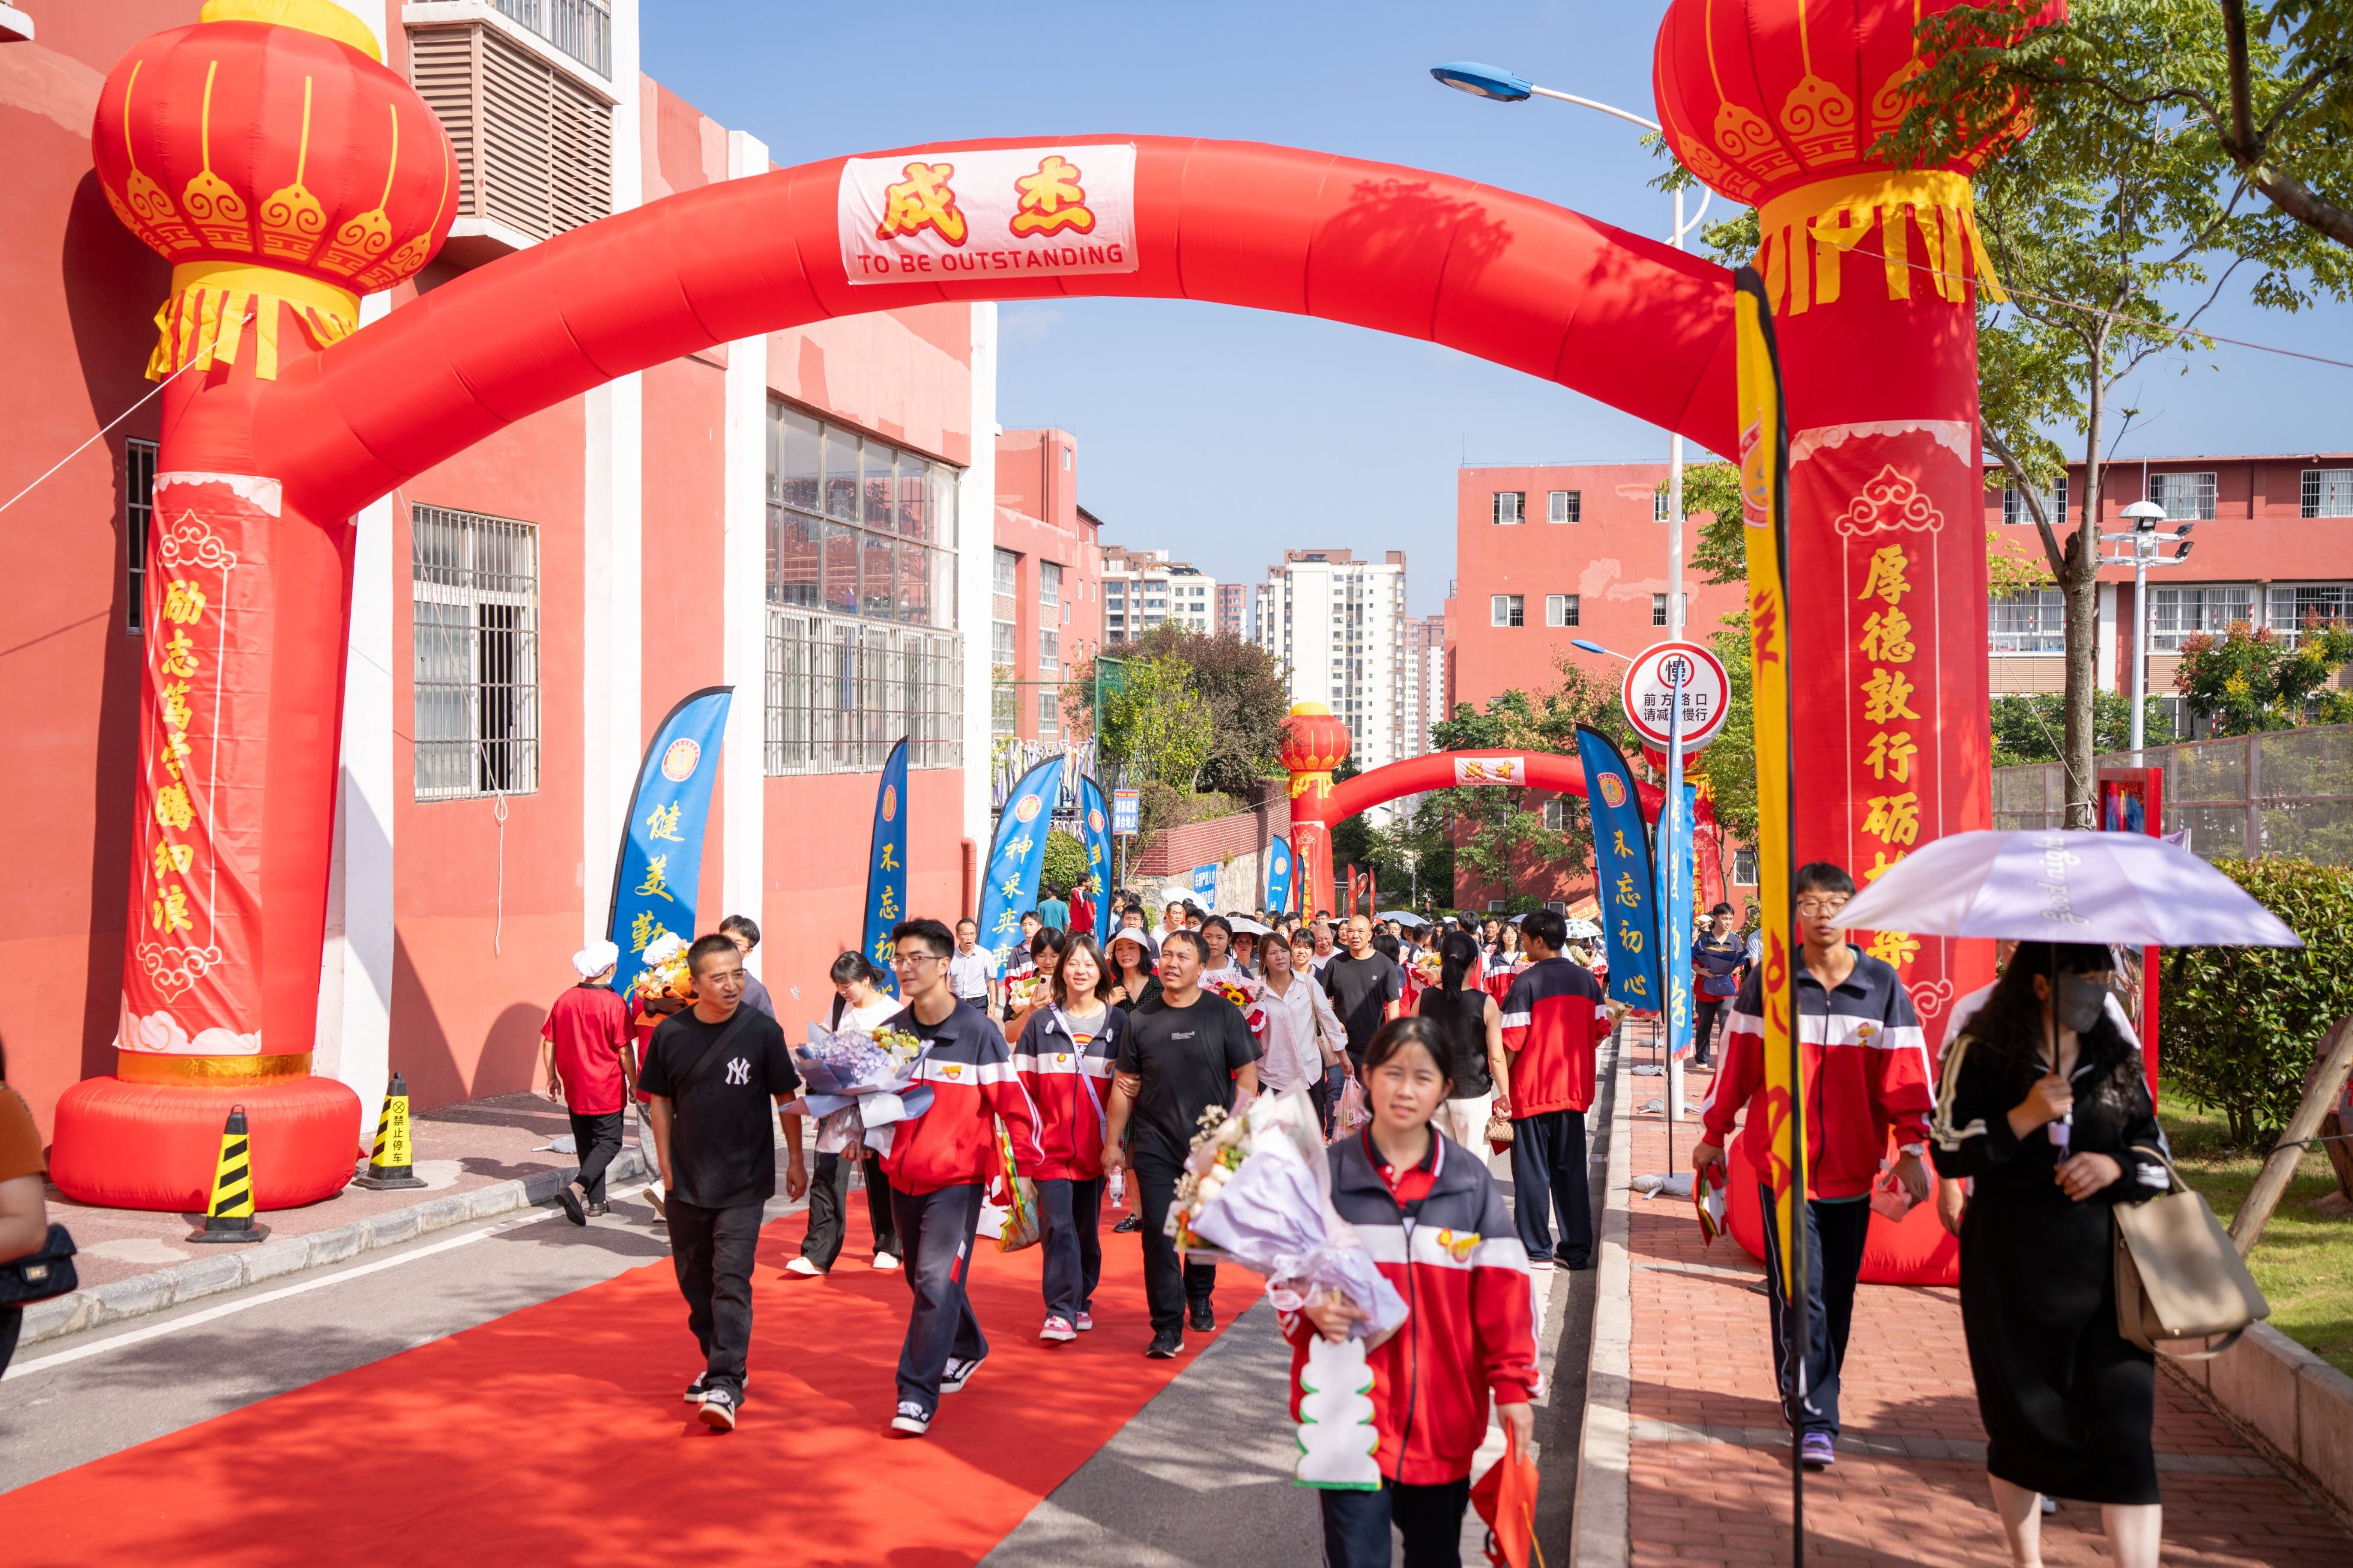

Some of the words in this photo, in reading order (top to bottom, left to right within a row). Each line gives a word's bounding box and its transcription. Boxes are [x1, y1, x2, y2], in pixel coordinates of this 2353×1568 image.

[875, 155, 1096, 247] 成杰
[858, 255, 890, 273] TO
[900, 253, 932, 272] BE
[941, 244, 1123, 271] OUTSTANDING
[1665, 660, 1686, 682] 慢
[1644, 693, 1707, 706] 前方路口
[1643, 708, 1708, 721] 请减慢行
[152, 579, 207, 934] 励志笃学腾细浪
[1114, 815, 1136, 828] 集合地点
[1614, 829, 1646, 995] 不忘初心
[725, 1056, 751, 1085] NY
[392, 1115, 404, 1163] 禁止停车
